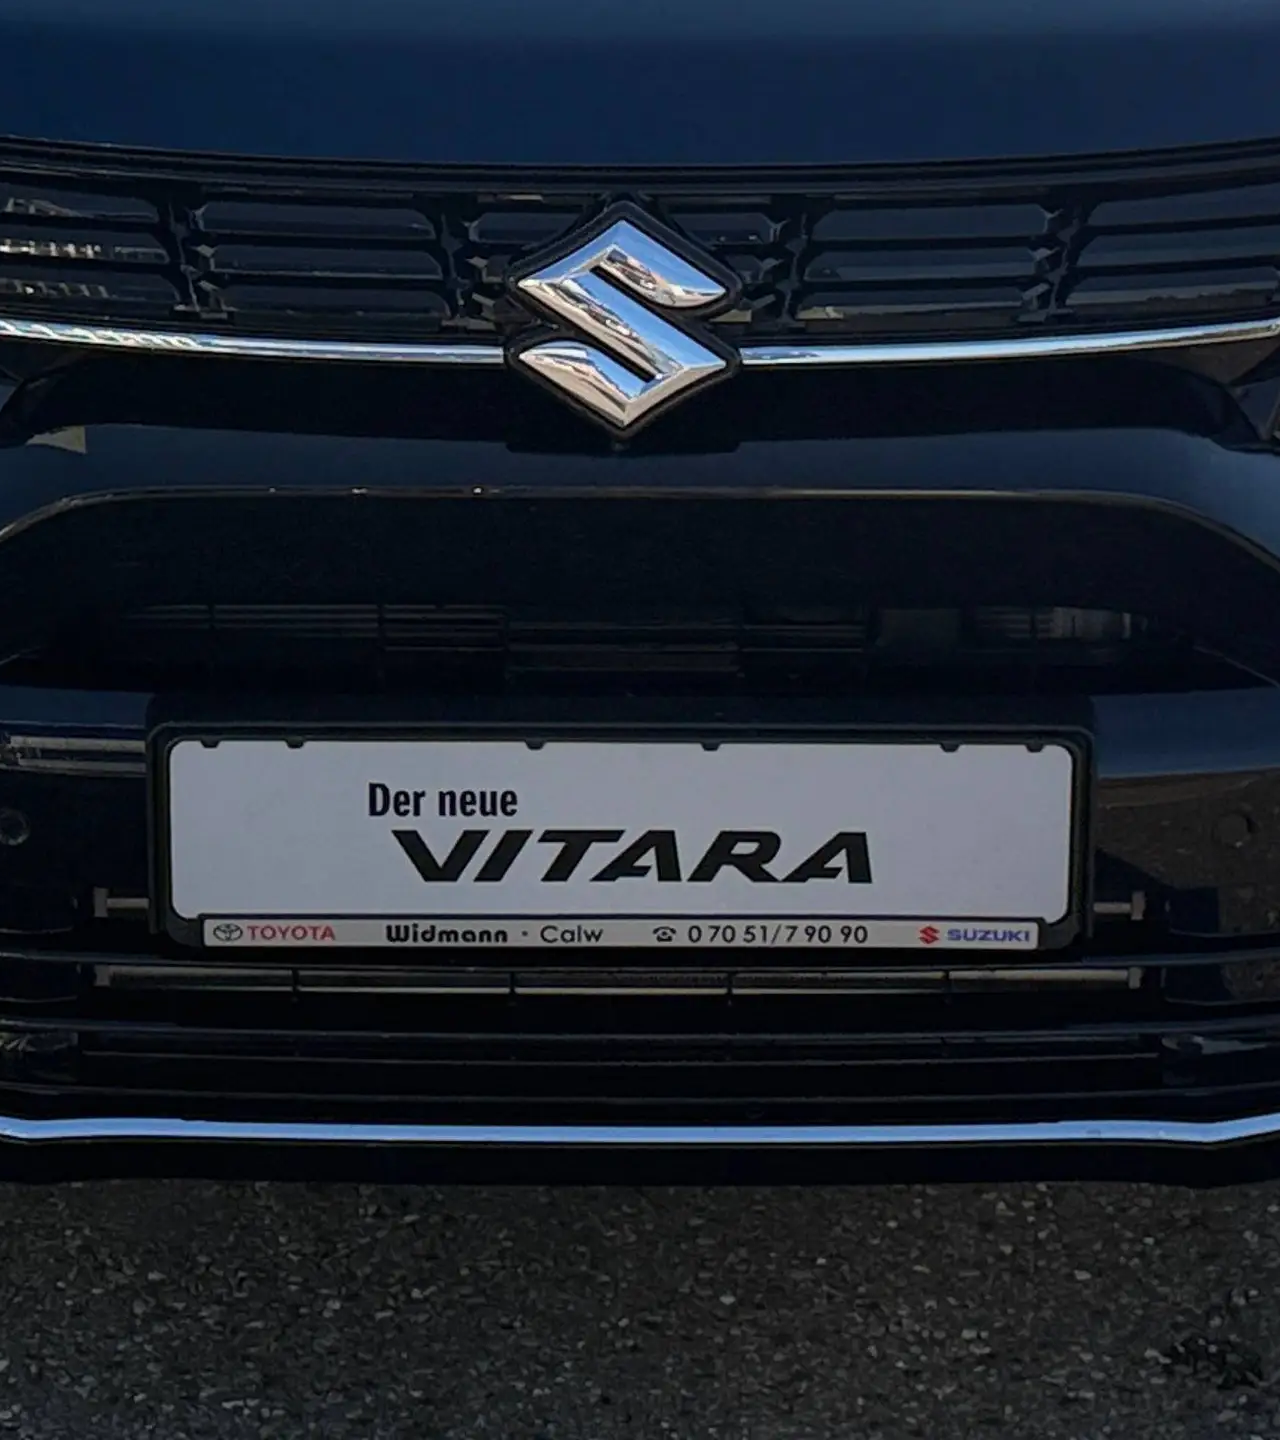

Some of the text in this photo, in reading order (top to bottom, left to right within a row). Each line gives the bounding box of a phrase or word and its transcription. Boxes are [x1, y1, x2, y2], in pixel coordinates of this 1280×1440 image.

[368, 782, 519, 817] Der neue
[391, 829, 873, 885] VITARA
[246, 925, 336, 942] TOYOTA
[385, 923, 604, 944] Widmann Calw
[947, 927, 1030, 943] SUZUKI
